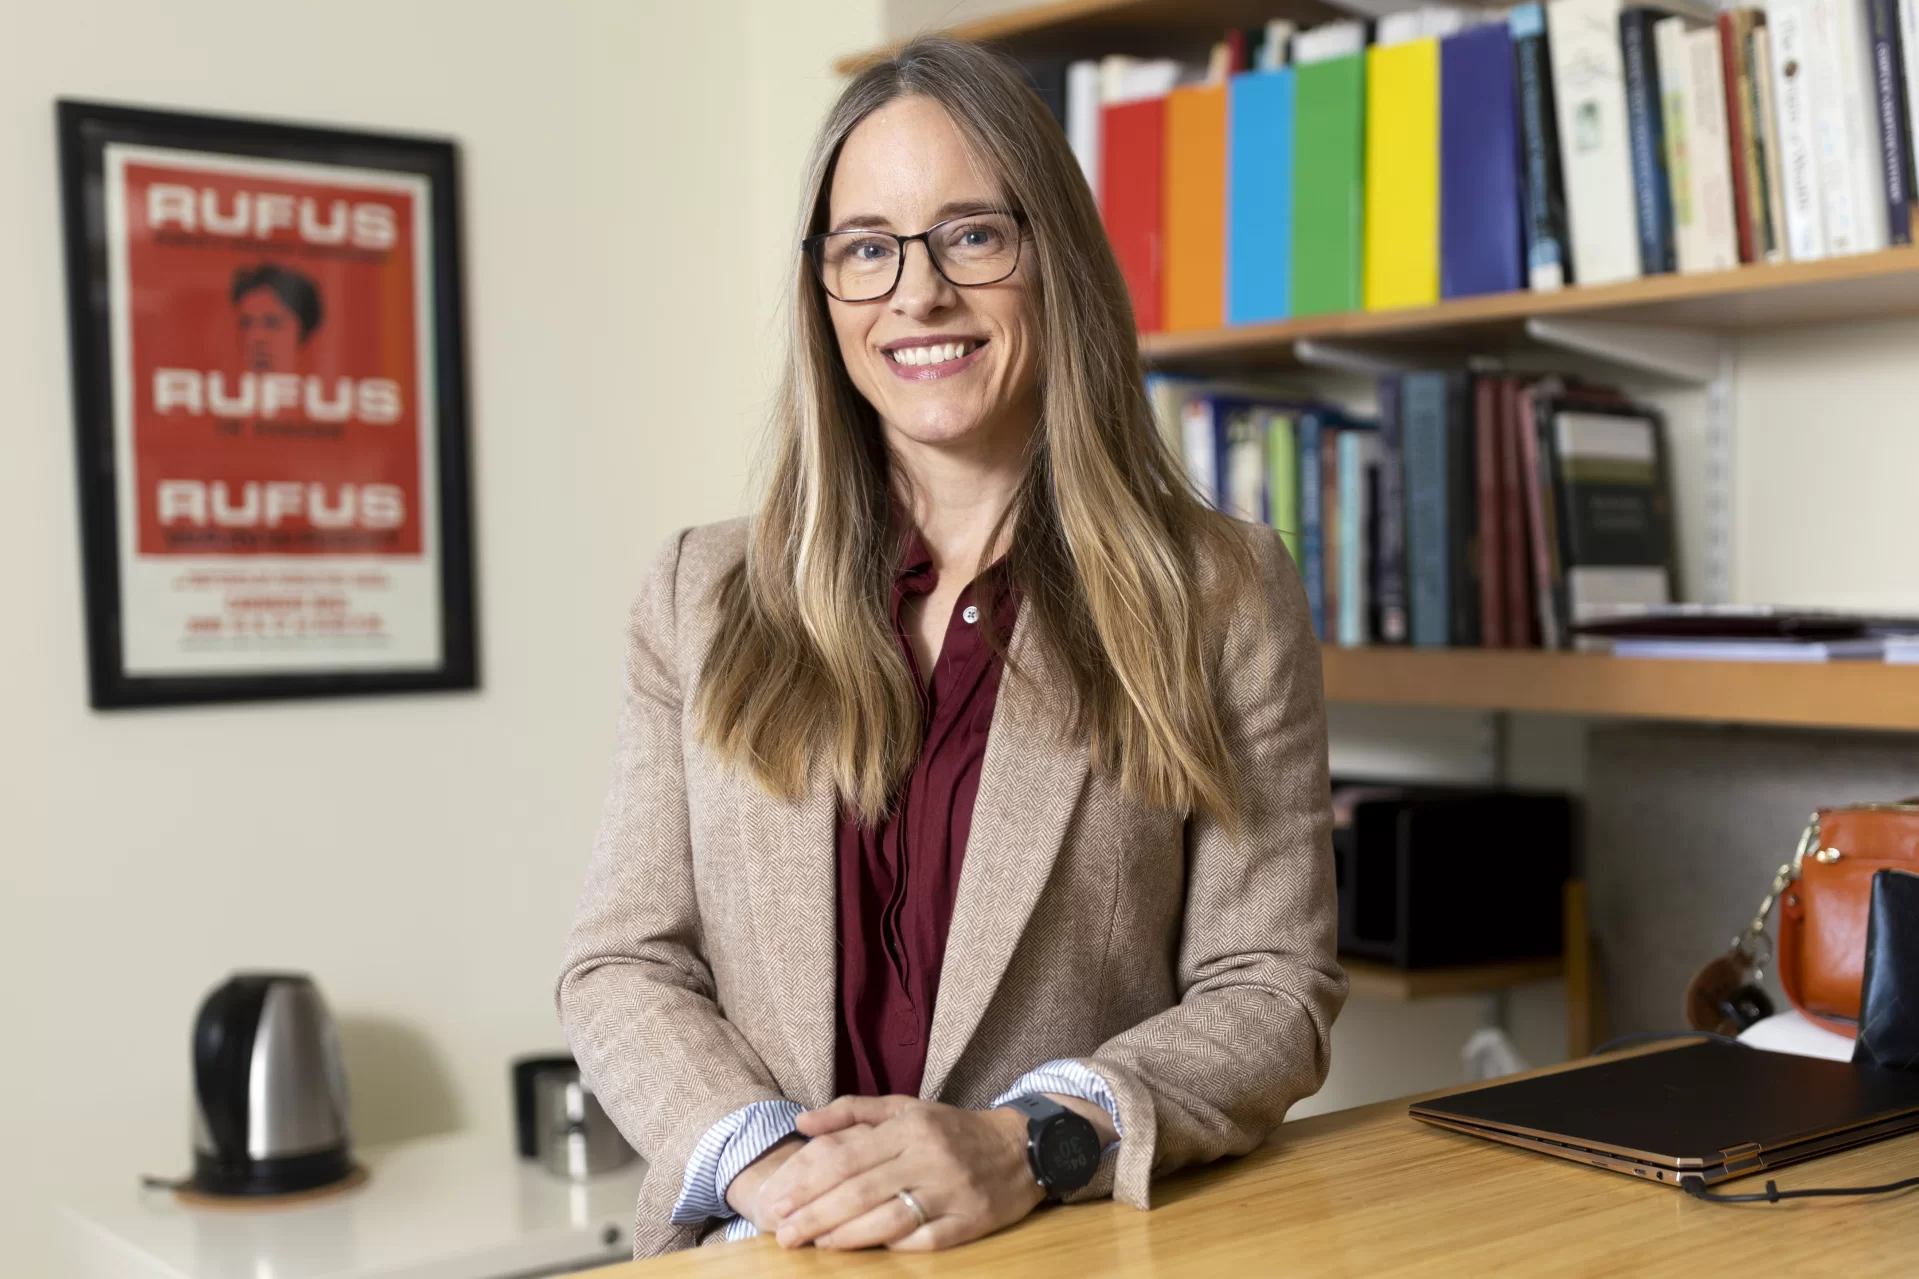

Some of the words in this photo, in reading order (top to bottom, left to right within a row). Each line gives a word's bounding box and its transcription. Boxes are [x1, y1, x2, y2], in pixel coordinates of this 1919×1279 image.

[147, 183, 398, 249] RUFUS
[153, 369, 403, 424] RUFUS
[157, 480, 405, 529] RUFUS
